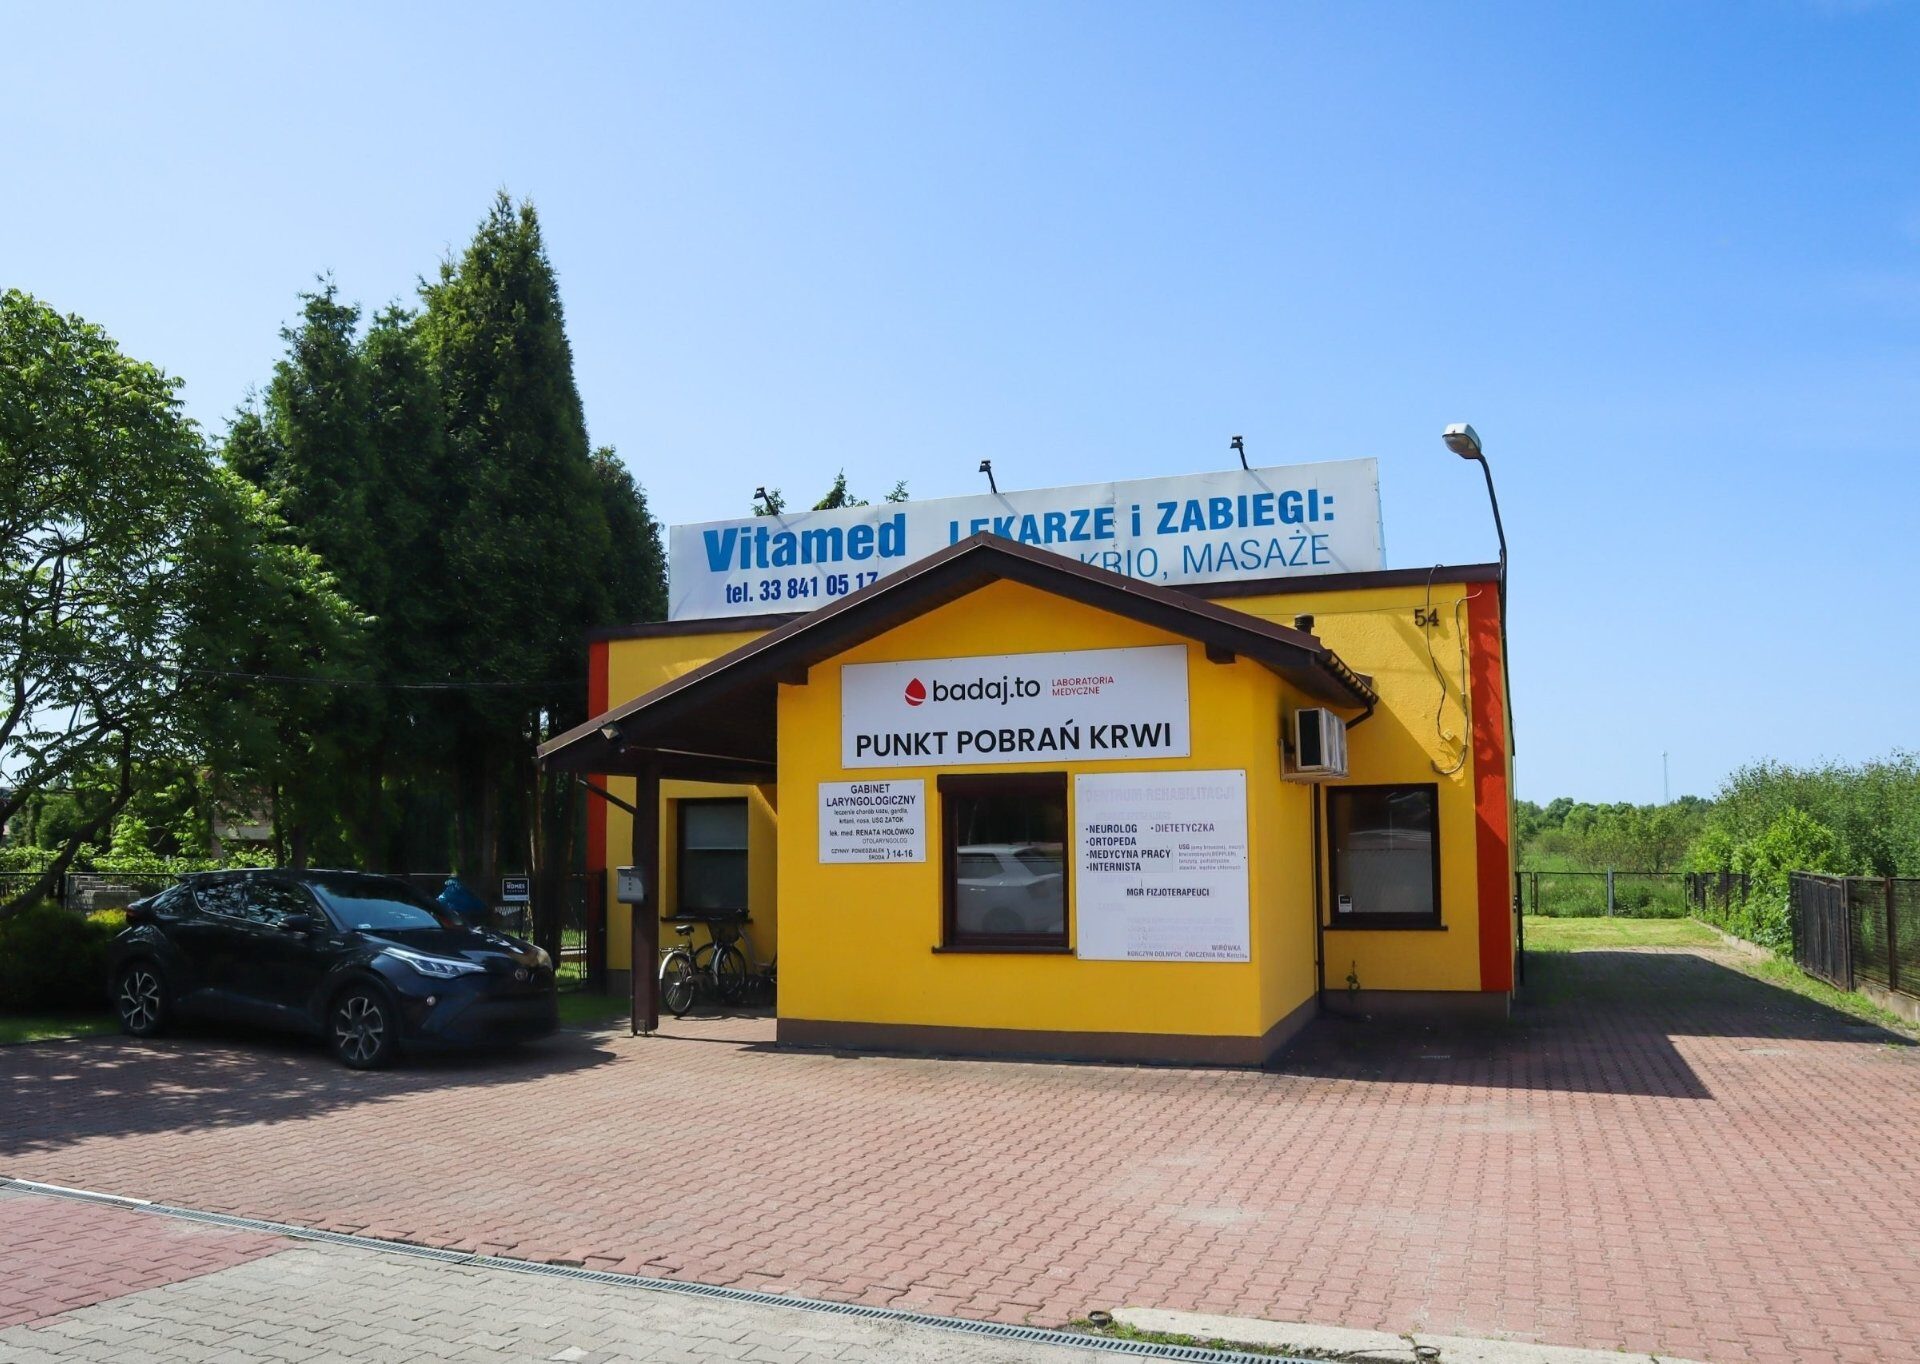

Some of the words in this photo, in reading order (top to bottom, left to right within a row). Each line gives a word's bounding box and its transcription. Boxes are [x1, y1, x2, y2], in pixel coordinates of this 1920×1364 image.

[1131, 504, 1141, 537] i
[1157, 489, 1335, 535] ZABIEGI:
[703, 513, 906, 573] Vitamed
[1183, 529, 1331, 575] MASAŻE
[726, 582, 754, 604] tel.
[759, 579, 782, 602] 33
[787, 576, 819, 599] 841
[826, 573, 849, 596] 05
[1414, 607, 1440, 627] 54
[1051, 676, 1115, 688] LABORATORIA
[932, 675, 1041, 705] badaj.to
[1051, 685, 1101, 697] MEDYCZNE
[855, 731, 949, 758] PUNKT
[957, 718, 1080, 754] POBRAŃ
[1090, 721, 1171, 750] KRWI
[826, 795, 916, 807] LARYNGOLOGICZNY
[855, 828, 881, 837] RENATA
[1089, 823, 1138, 834] NEUROLOG
[1154, 822, 1215, 833] DIETETYCZKA
[1089, 836, 1137, 847] ORTOPEDA
[892, 849, 914, 858] 14-16
[1089, 849, 1139, 860] MEDYCYNA
[1141, 848, 1171, 859] PRACY
[1089, 862, 1142, 873] INTERNISTA
[1126, 887, 1145, 897] MGR
[1146, 887, 1211, 897] FIZJOTERAPEUCI
